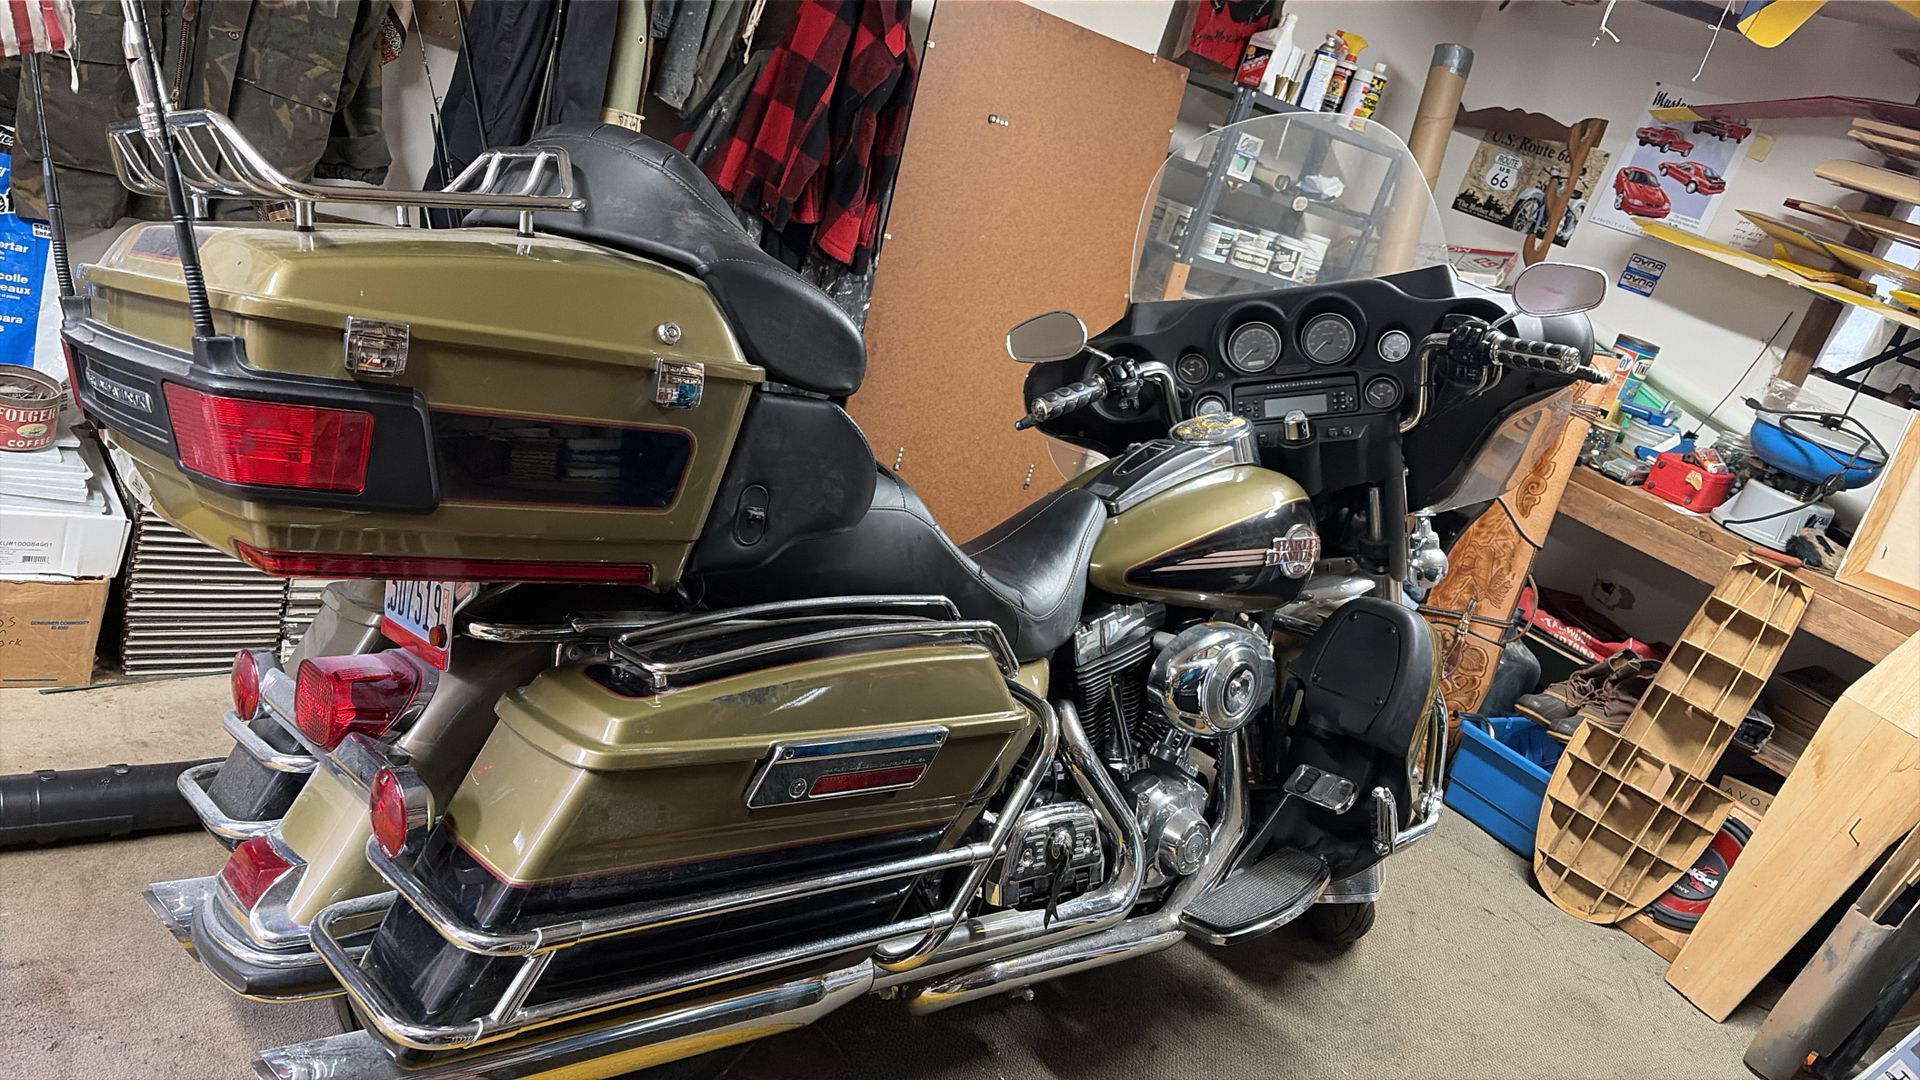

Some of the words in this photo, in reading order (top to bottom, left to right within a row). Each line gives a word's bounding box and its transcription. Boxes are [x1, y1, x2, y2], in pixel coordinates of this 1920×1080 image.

[1519, 136, 1556, 159] Route
[1497, 154, 1521, 169] ROUTE
[1490, 173, 1509, 189] 66
